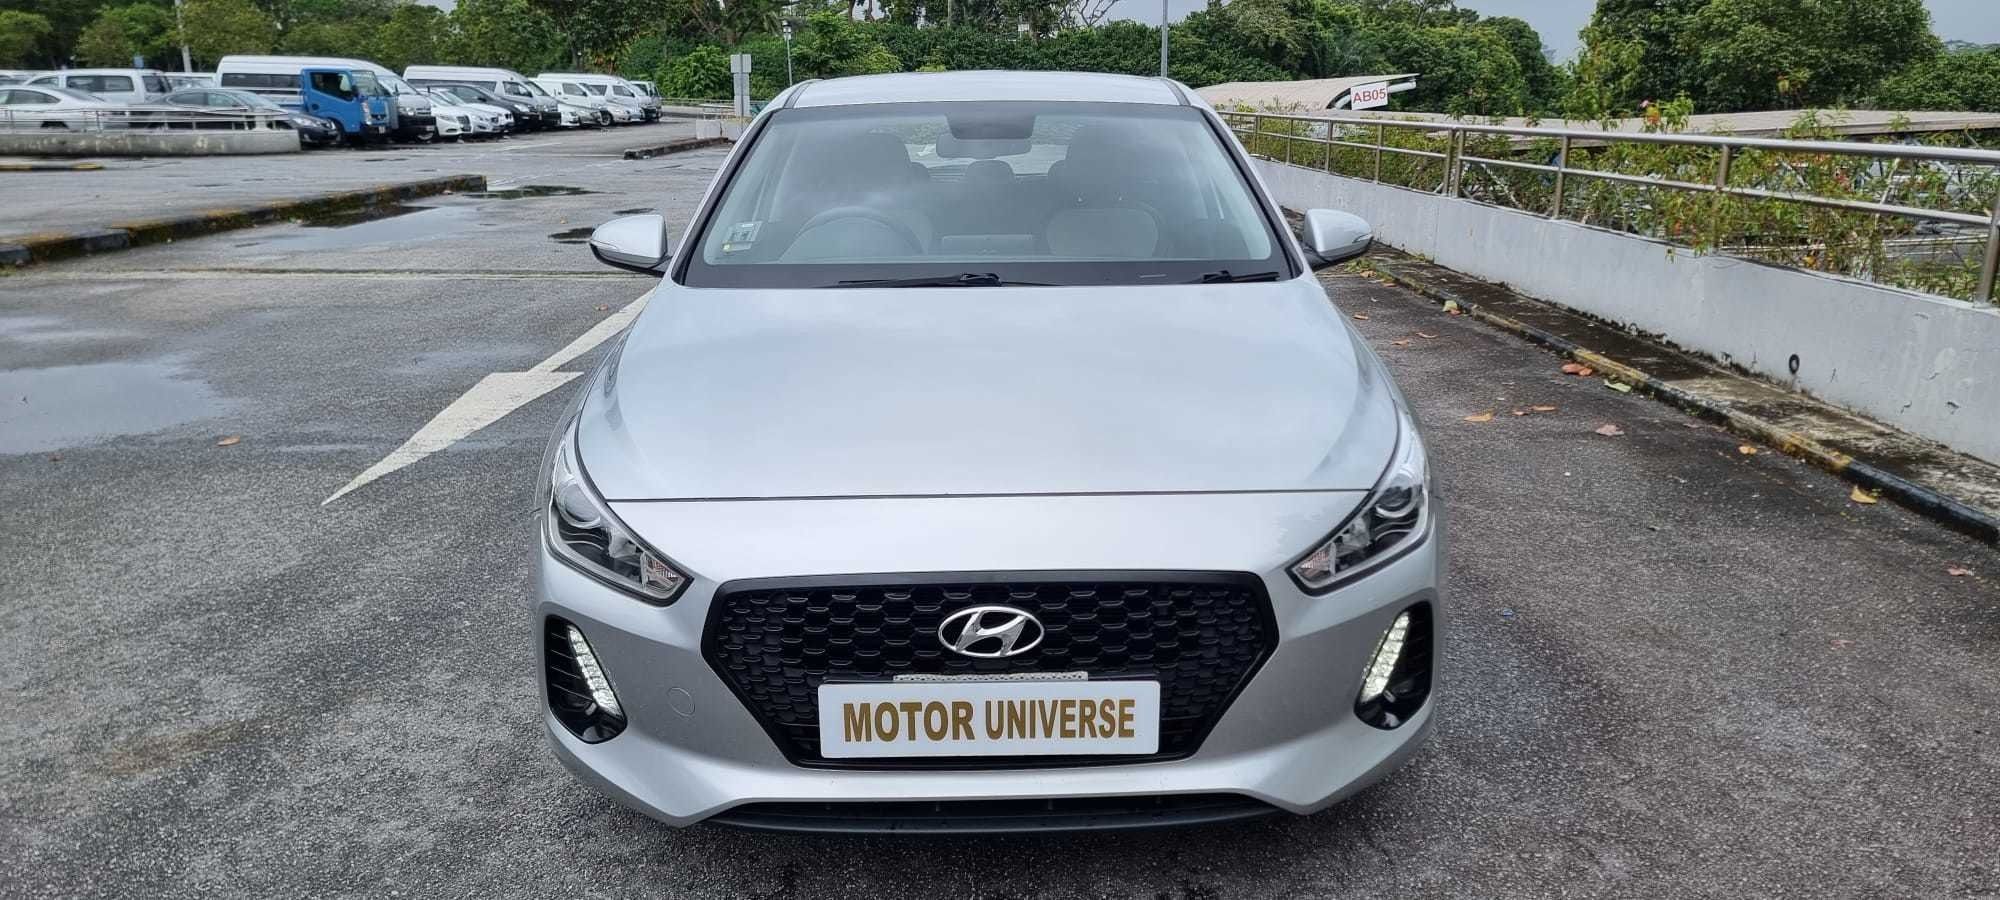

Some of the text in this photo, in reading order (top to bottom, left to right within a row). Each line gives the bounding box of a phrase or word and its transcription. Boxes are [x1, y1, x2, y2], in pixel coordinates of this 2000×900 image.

[1353, 88, 1386, 104] AB05
[843, 698, 1136, 742] MOTOR UNIVERSE
